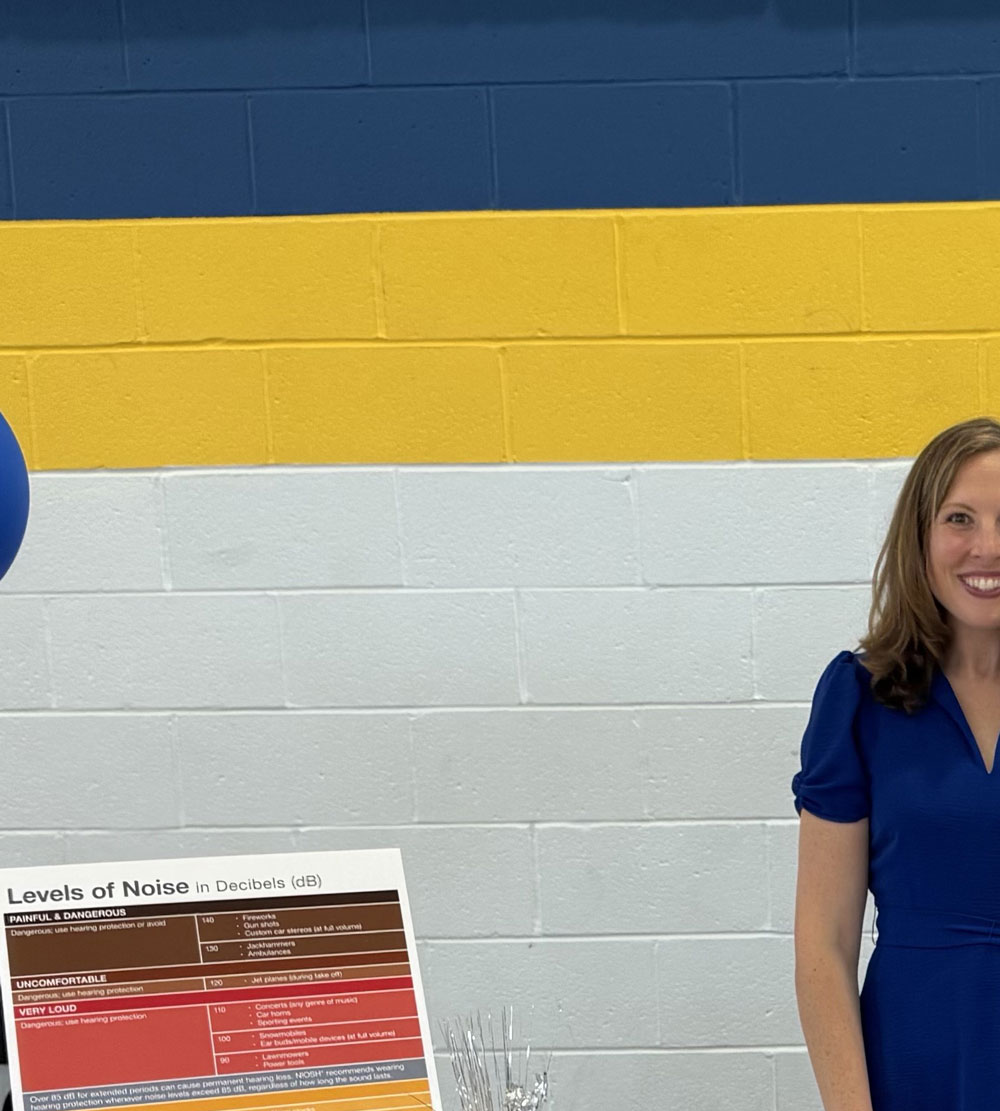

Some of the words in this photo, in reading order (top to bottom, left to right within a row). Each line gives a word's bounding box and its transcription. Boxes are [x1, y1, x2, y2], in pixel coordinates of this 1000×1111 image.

[8, 885, 83, 904] Levels
[92, 882, 115, 899] of
[123, 879, 189, 897] Noise
[196, 881, 209, 893] in
[216, 877, 285, 892] Decibels
[291, 874, 322, 889] (dB)
[10, 914, 51, 923] PAINFUL
[54, 912, 61, 920] &
[64, 909, 126, 919] DANGEROUS
[242, 913, 276, 921] Fireworks
[70, 924, 97, 933] hearing
[100, 922, 135, 931] protection
[247, 940, 295, 949] Jackhammers
[17, 975, 107, 988] UNCOMFORTABLE
[78, 989, 104, 998] hearing
[107, 986, 143, 996] protection
[19, 1006, 45, 1016] VERY
[48, 1005, 77, 1013] LOUD
[214, 1006, 226, 1014] 110
[257, 1018, 287, 1027] Sporting
[289, 1016, 312, 1024] events
[259, 1030, 306, 1040] Snowmobiles
[220, 1056, 230, 1064] 90
[262, 1050, 309, 1060] Lawnmowers
[30, 1096, 48, 1104] Over
[91, 1088, 127, 1097] extended
[130, 1086, 159, 1095] periods
[177, 1082, 200, 1090] cause
[203, 1078, 244, 1089] permanent
[246, 1074, 274, 1084] hearing
[326, 1066, 374, 1076] recommends
[376, 1064, 404, 1072] wearing
[30, 1102, 60, 1111] hearing
[63, 1099, 103, 1109] protection
[105, 1096, 142, 1104] whenever
[168, 1090, 189, 1098] levels
[192, 1088, 219, 1096] exceed
[221, 1086, 231, 1094] 85
[249, 1082, 289, 1092] regardless
[290, 1080, 298, 1088] of
[300, 1078, 314, 1086] how
[317, 1077, 333, 1088] long
[349, 1073, 371, 1081] sound
